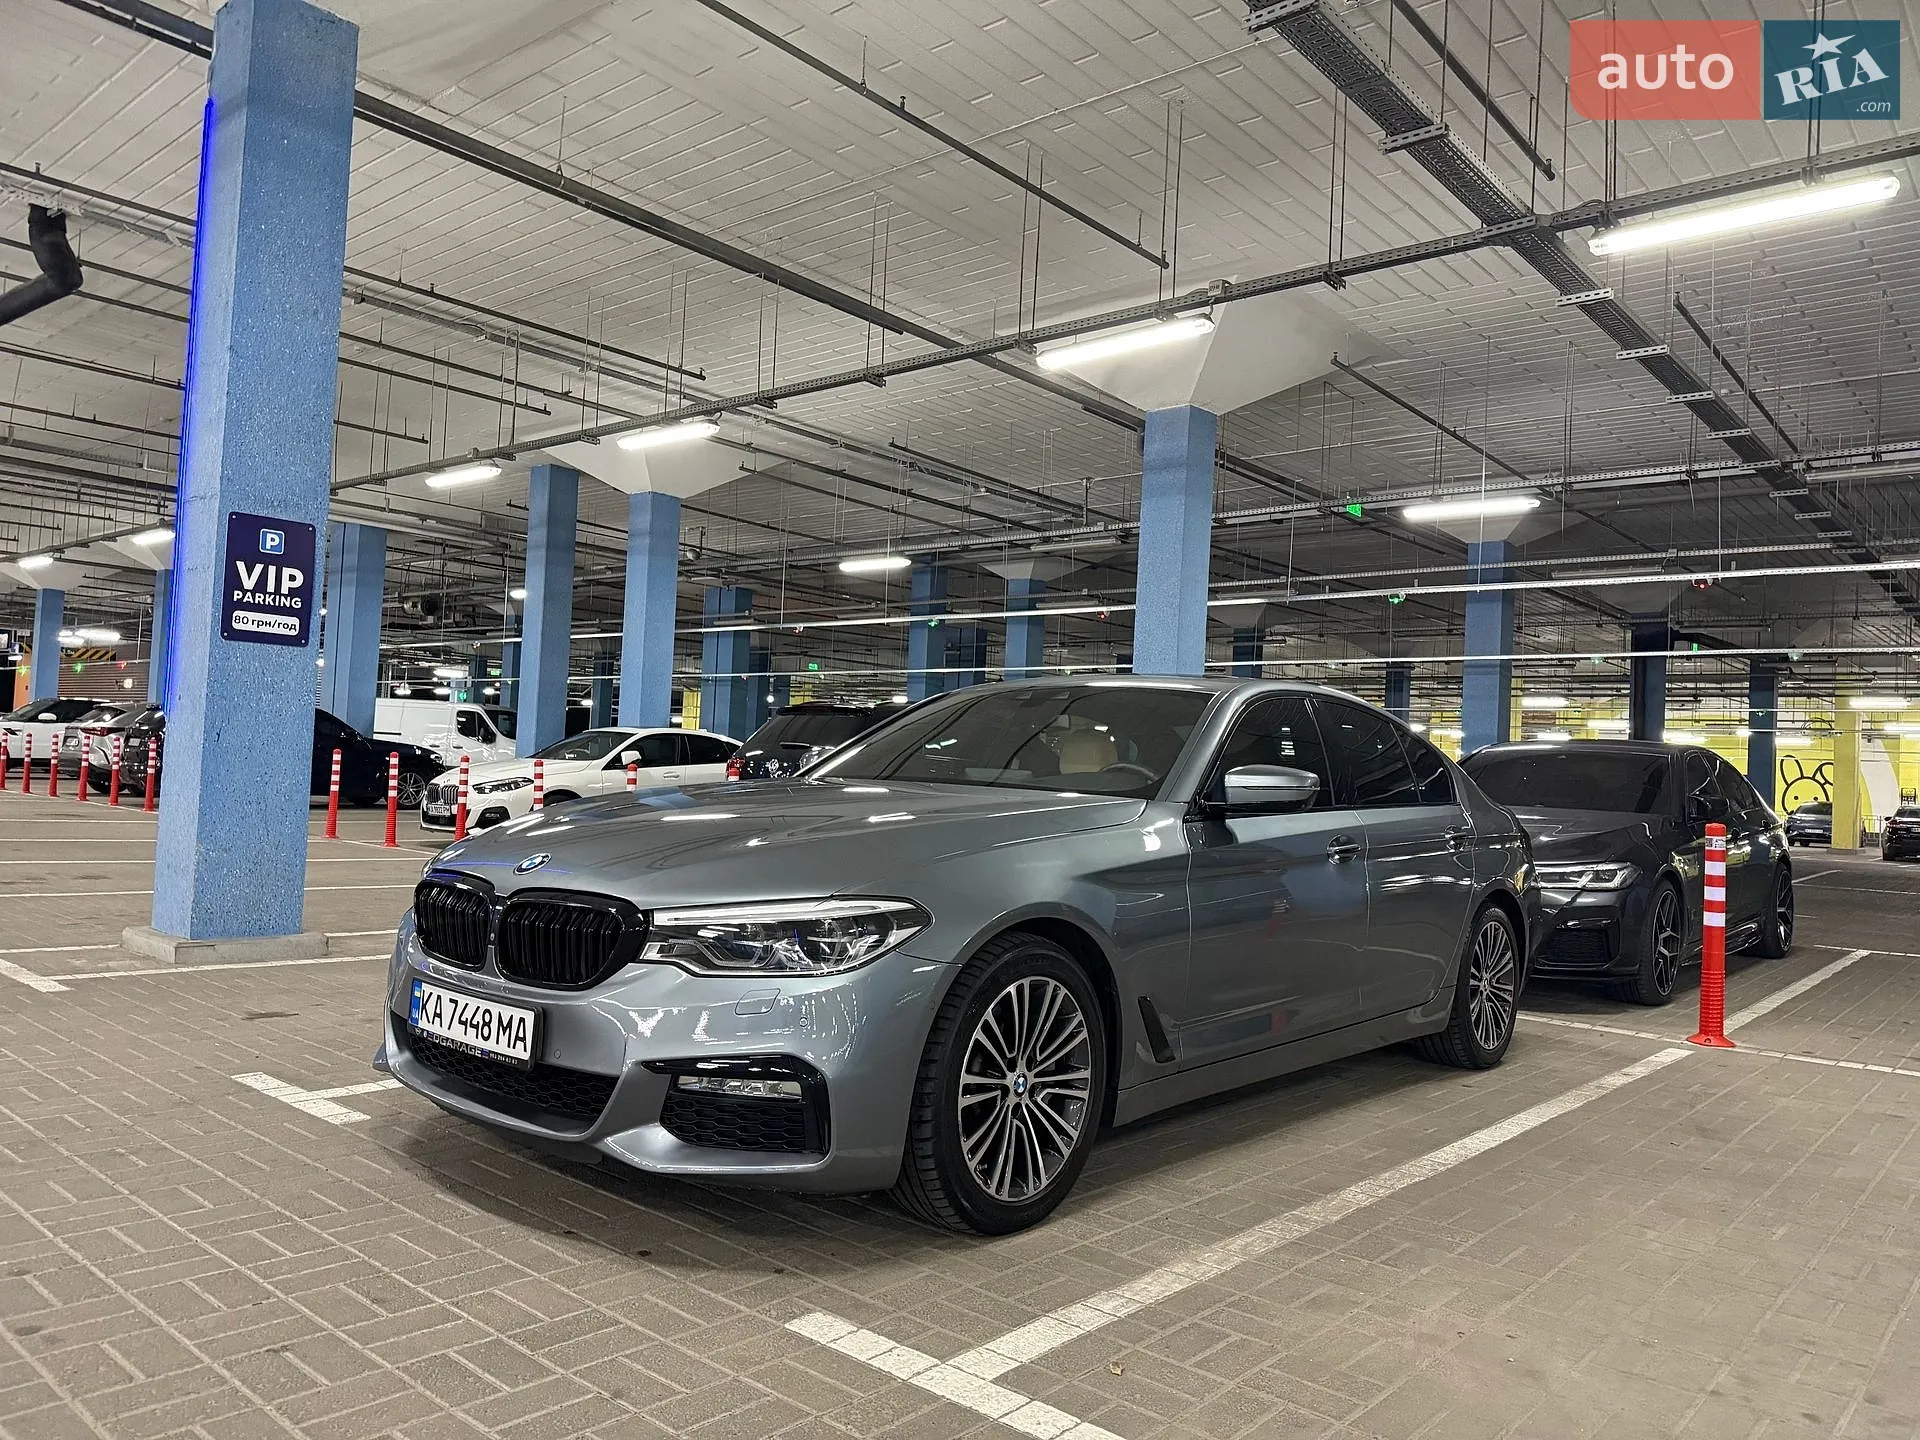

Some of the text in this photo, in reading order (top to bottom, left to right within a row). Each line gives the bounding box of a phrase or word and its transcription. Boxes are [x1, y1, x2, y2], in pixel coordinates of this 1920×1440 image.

[266, 533, 280, 550] P
[236, 561, 304, 594] VIP
[233, 590, 302, 609] PARKING
[234, 615, 297, 632] 80 грн/год
[448, 998, 493, 1041] 7448
